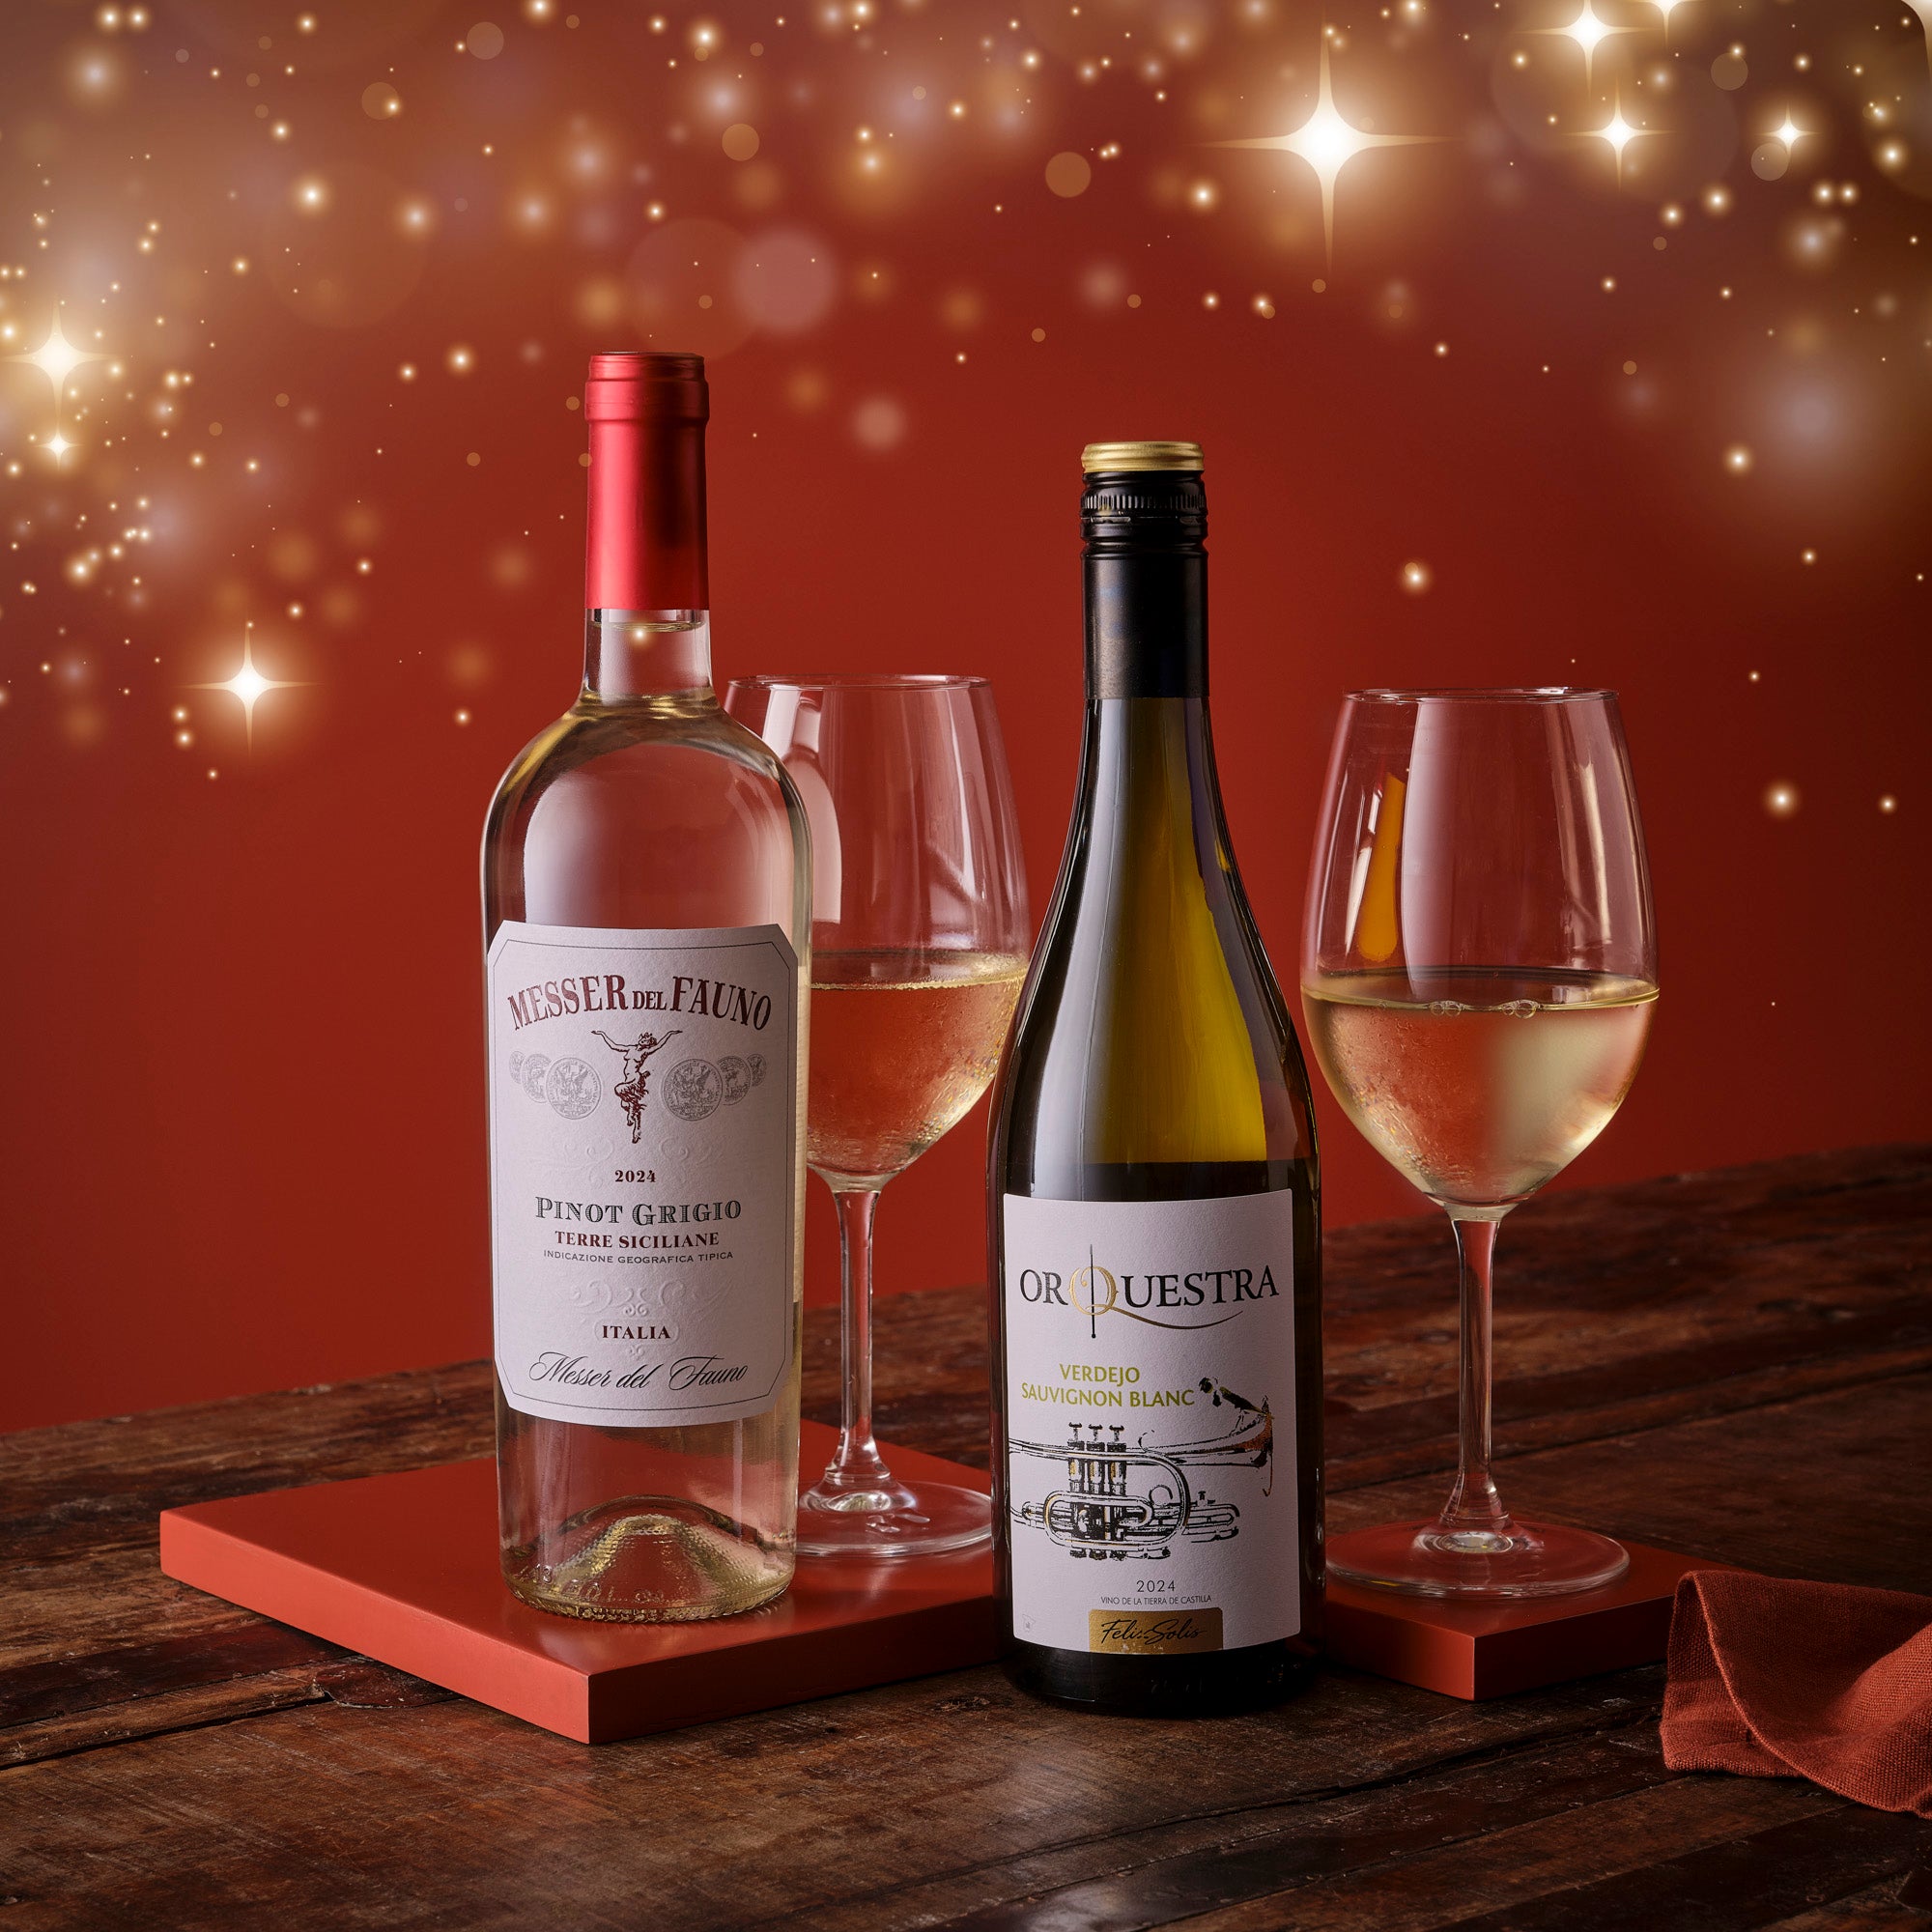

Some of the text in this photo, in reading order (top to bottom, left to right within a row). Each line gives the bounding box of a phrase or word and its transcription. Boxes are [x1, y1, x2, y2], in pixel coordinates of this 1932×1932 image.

[507, 974, 773, 1031] MESSER DEL FAUNO
[614, 1169, 657, 1183] 2024
[535, 1196, 742, 1227] PINOT GRIGIO
[554, 1230, 720, 1249] TERRE SICILIANE
[543, 1249, 734, 1264] INDICAZIONE GEOGRAFICA TIPICA
[1020, 1264, 1280, 1329] ORQUESTRA
[602, 1324, 671, 1340] ITALIA
[529, 1351, 749, 1391] Messer del Fauno
[1059, 1363, 1141, 1387] VERDEJO
[1021, 1382, 1195, 1407] SAUVIGNON BLANC
[1136, 1579, 1176, 1593] 2024
[1100, 1596, 1121, 1605] VINO
[1122, 1597, 1132, 1605] DE
[1133, 1597, 1142, 1605] LA
[1144, 1597, 1168, 1605] TIERRA
[1180, 1594, 1212, 1605] CASTILLA
